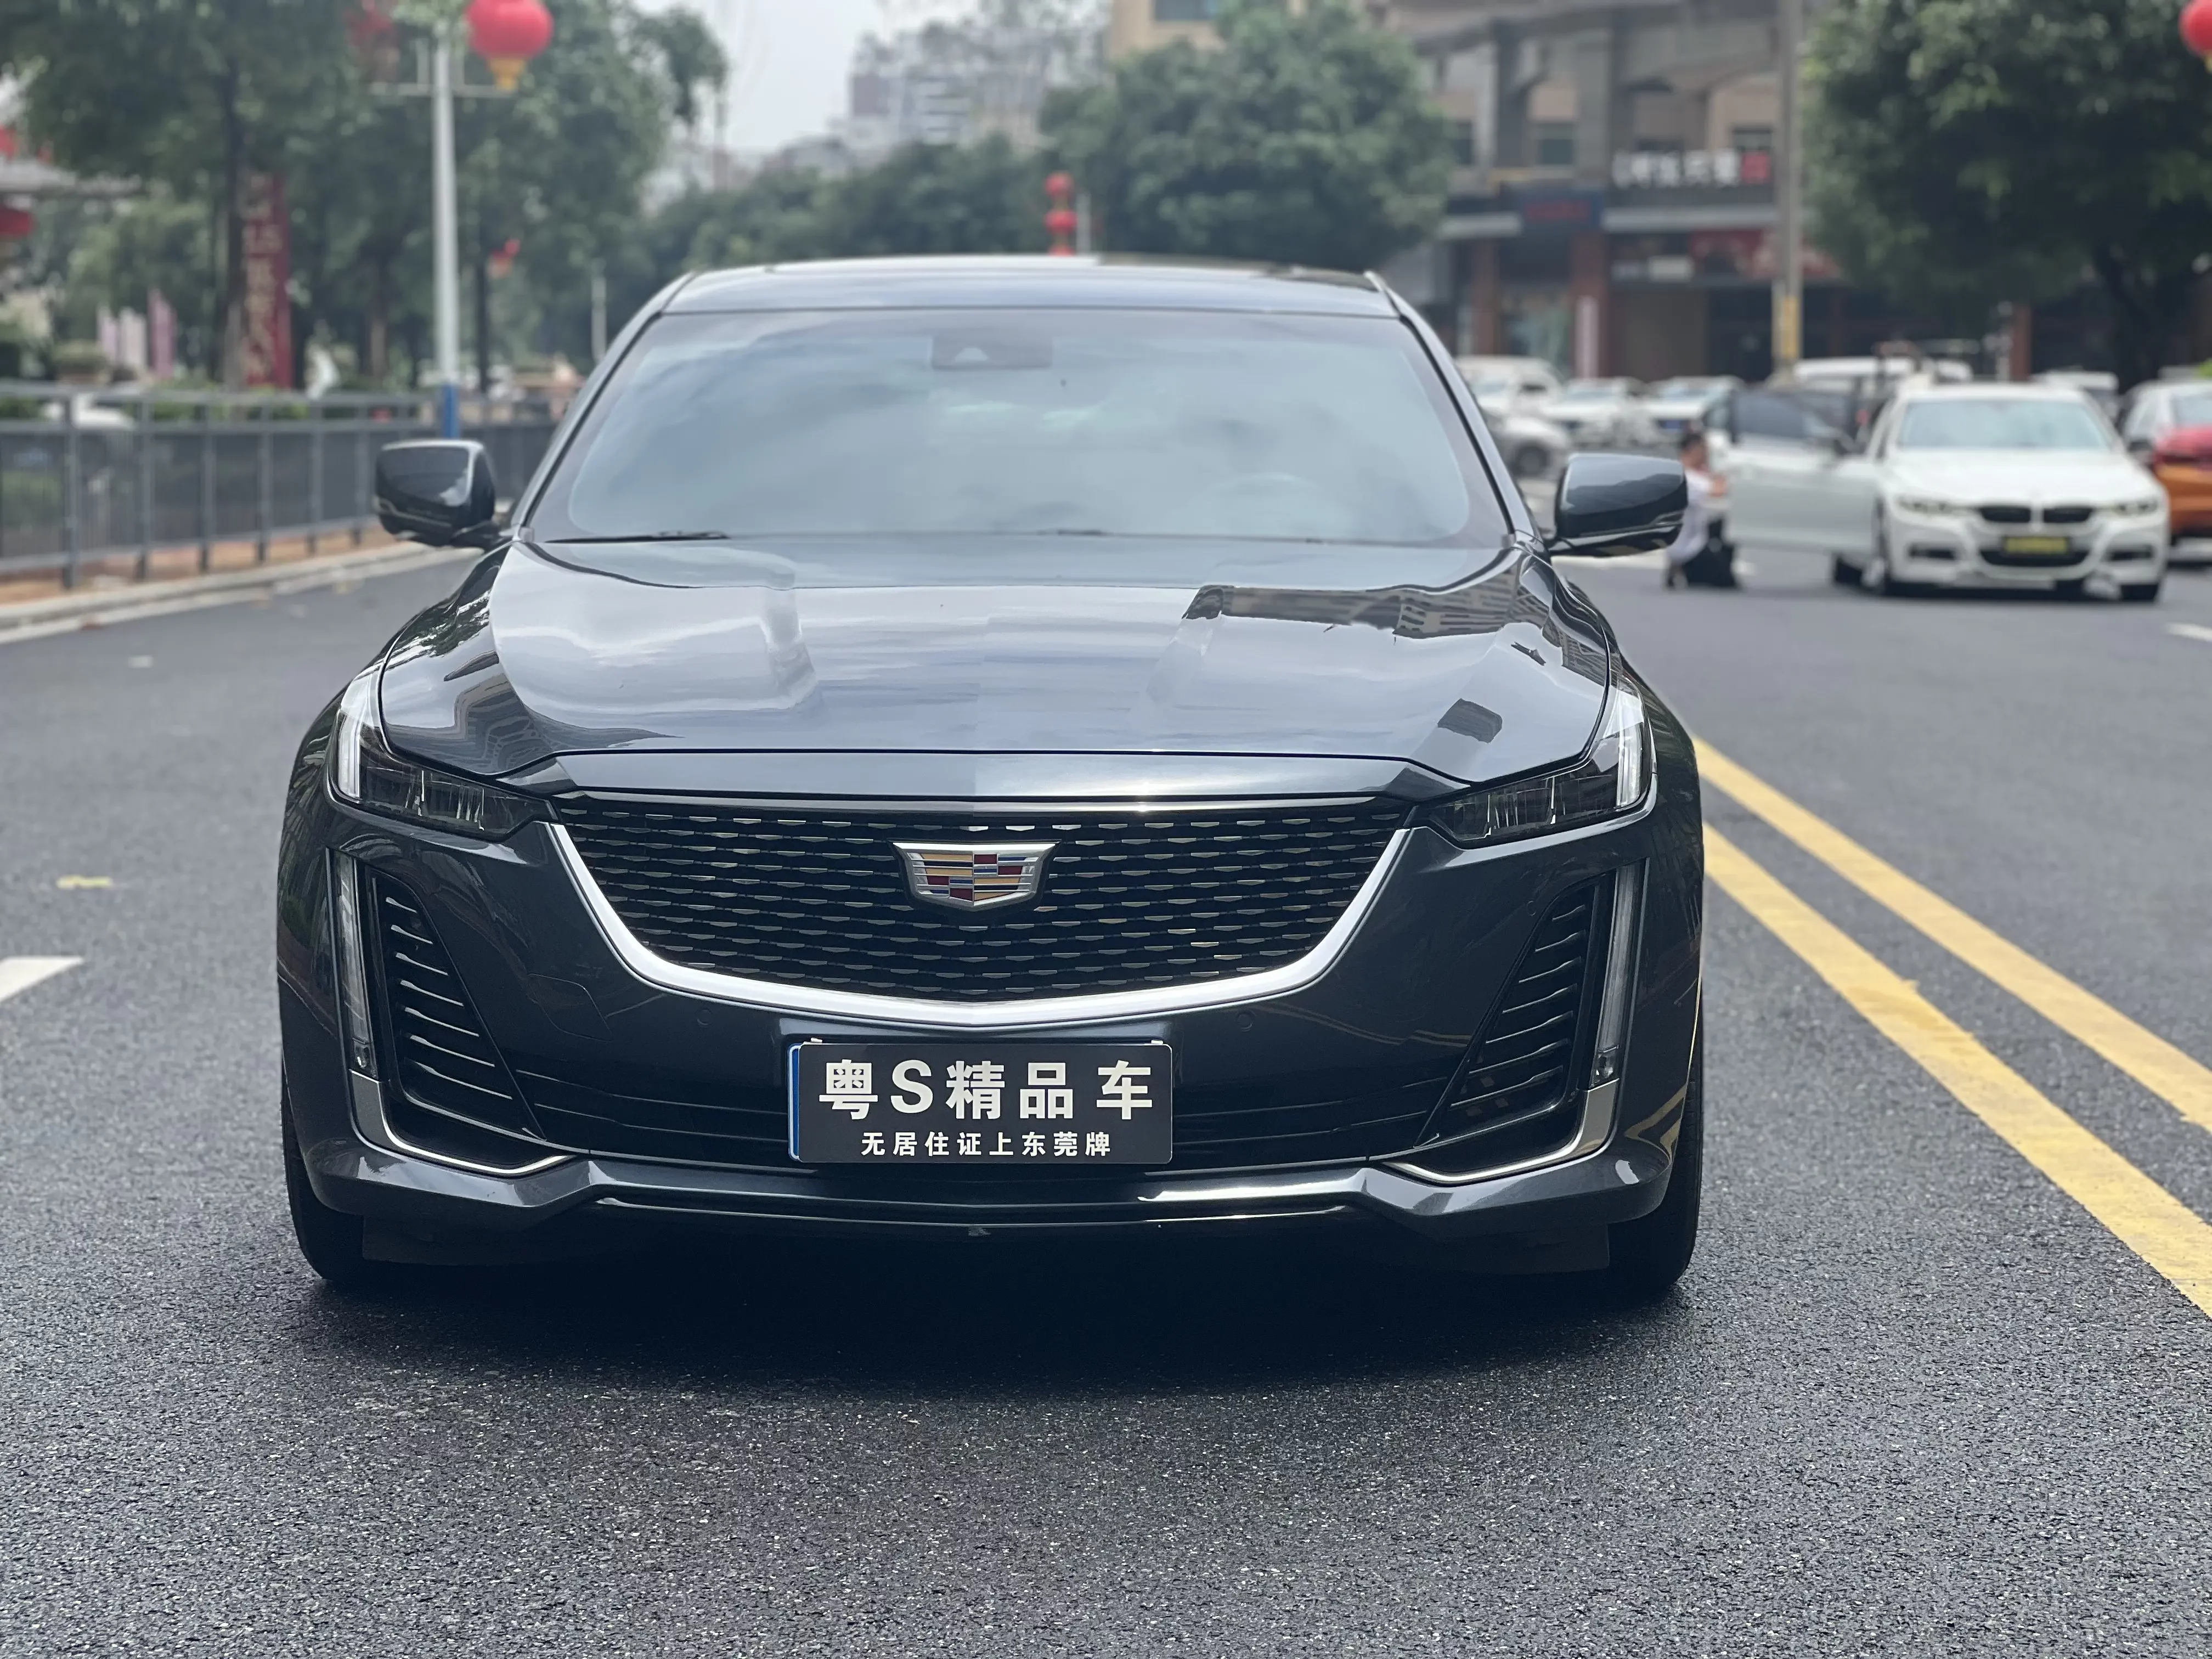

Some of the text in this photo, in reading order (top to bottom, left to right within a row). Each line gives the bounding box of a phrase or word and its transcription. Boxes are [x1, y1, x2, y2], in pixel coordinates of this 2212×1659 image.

[819, 1059, 1153, 1120] 粤S精品车
[861, 1131, 1111, 1156] 无居住证上东莞牌
